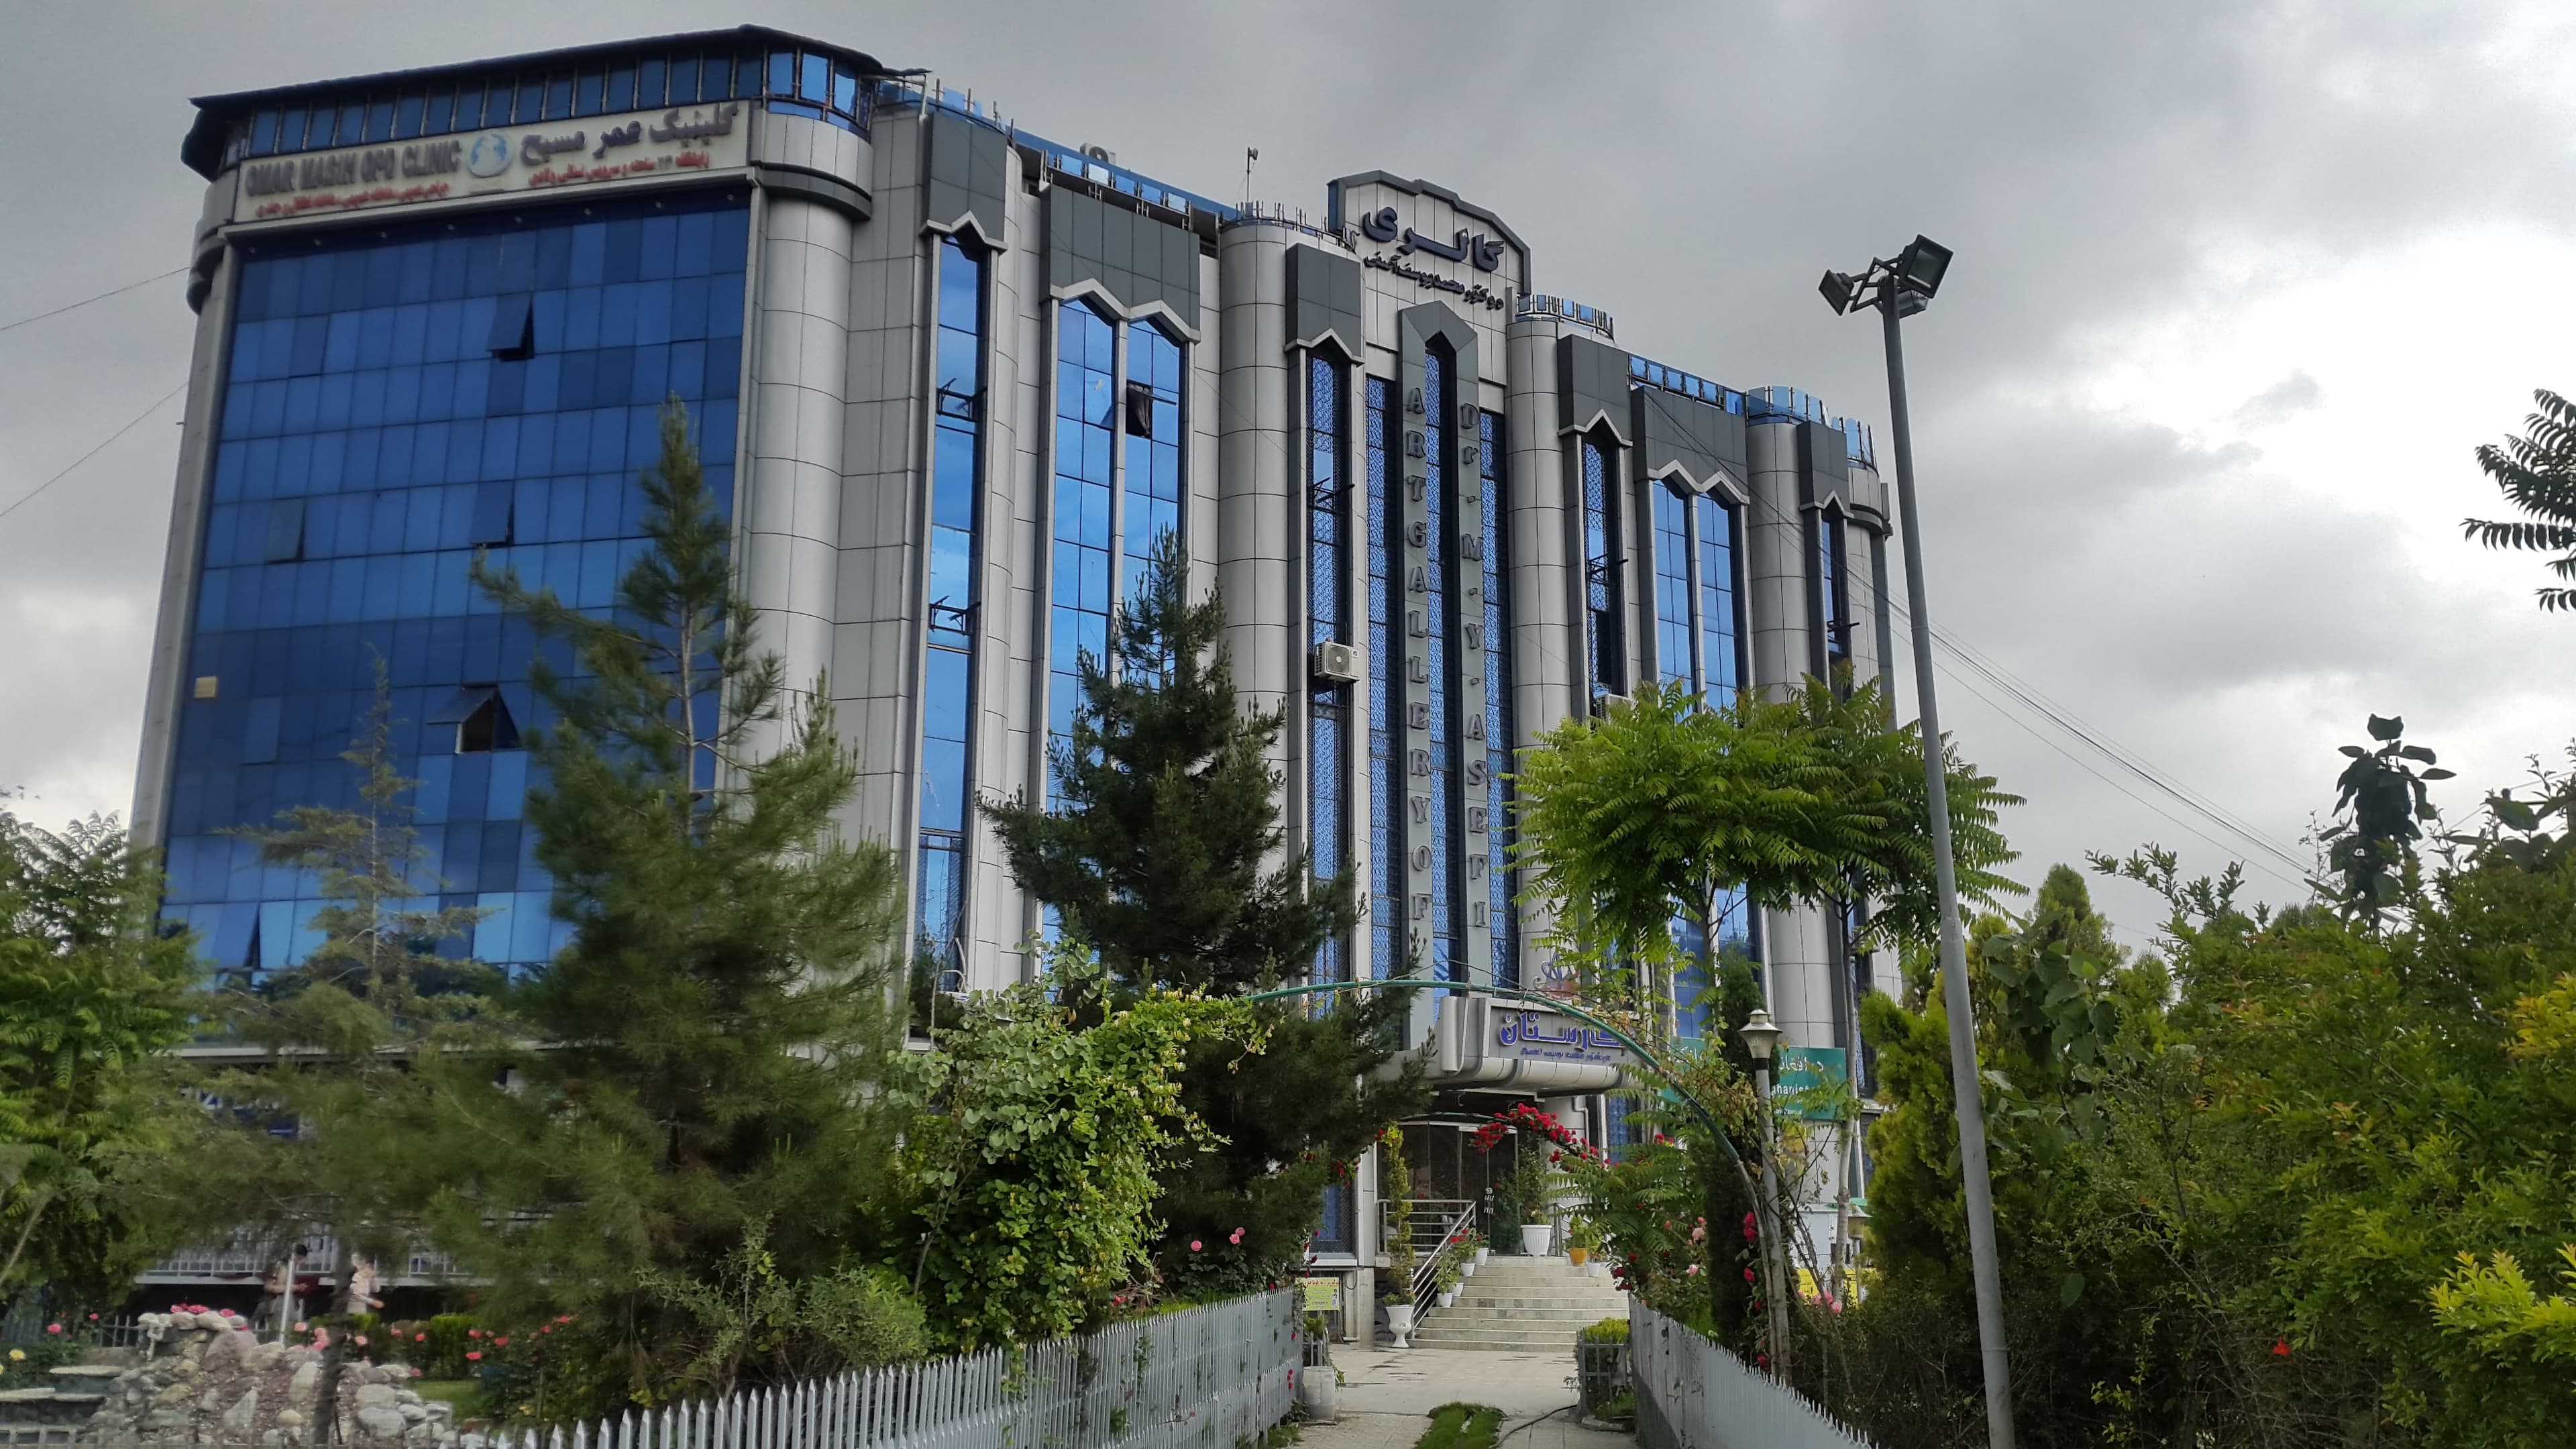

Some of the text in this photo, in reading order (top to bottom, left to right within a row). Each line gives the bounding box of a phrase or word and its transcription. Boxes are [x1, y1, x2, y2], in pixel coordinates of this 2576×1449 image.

[519, 130, 586, 166] مسیح
[592, 119, 641, 159] عمر
[244, 160, 296, 197] OMAR
[400, 139, 462, 178] CLINIC
[1362, 207, 1505, 272] گالری
